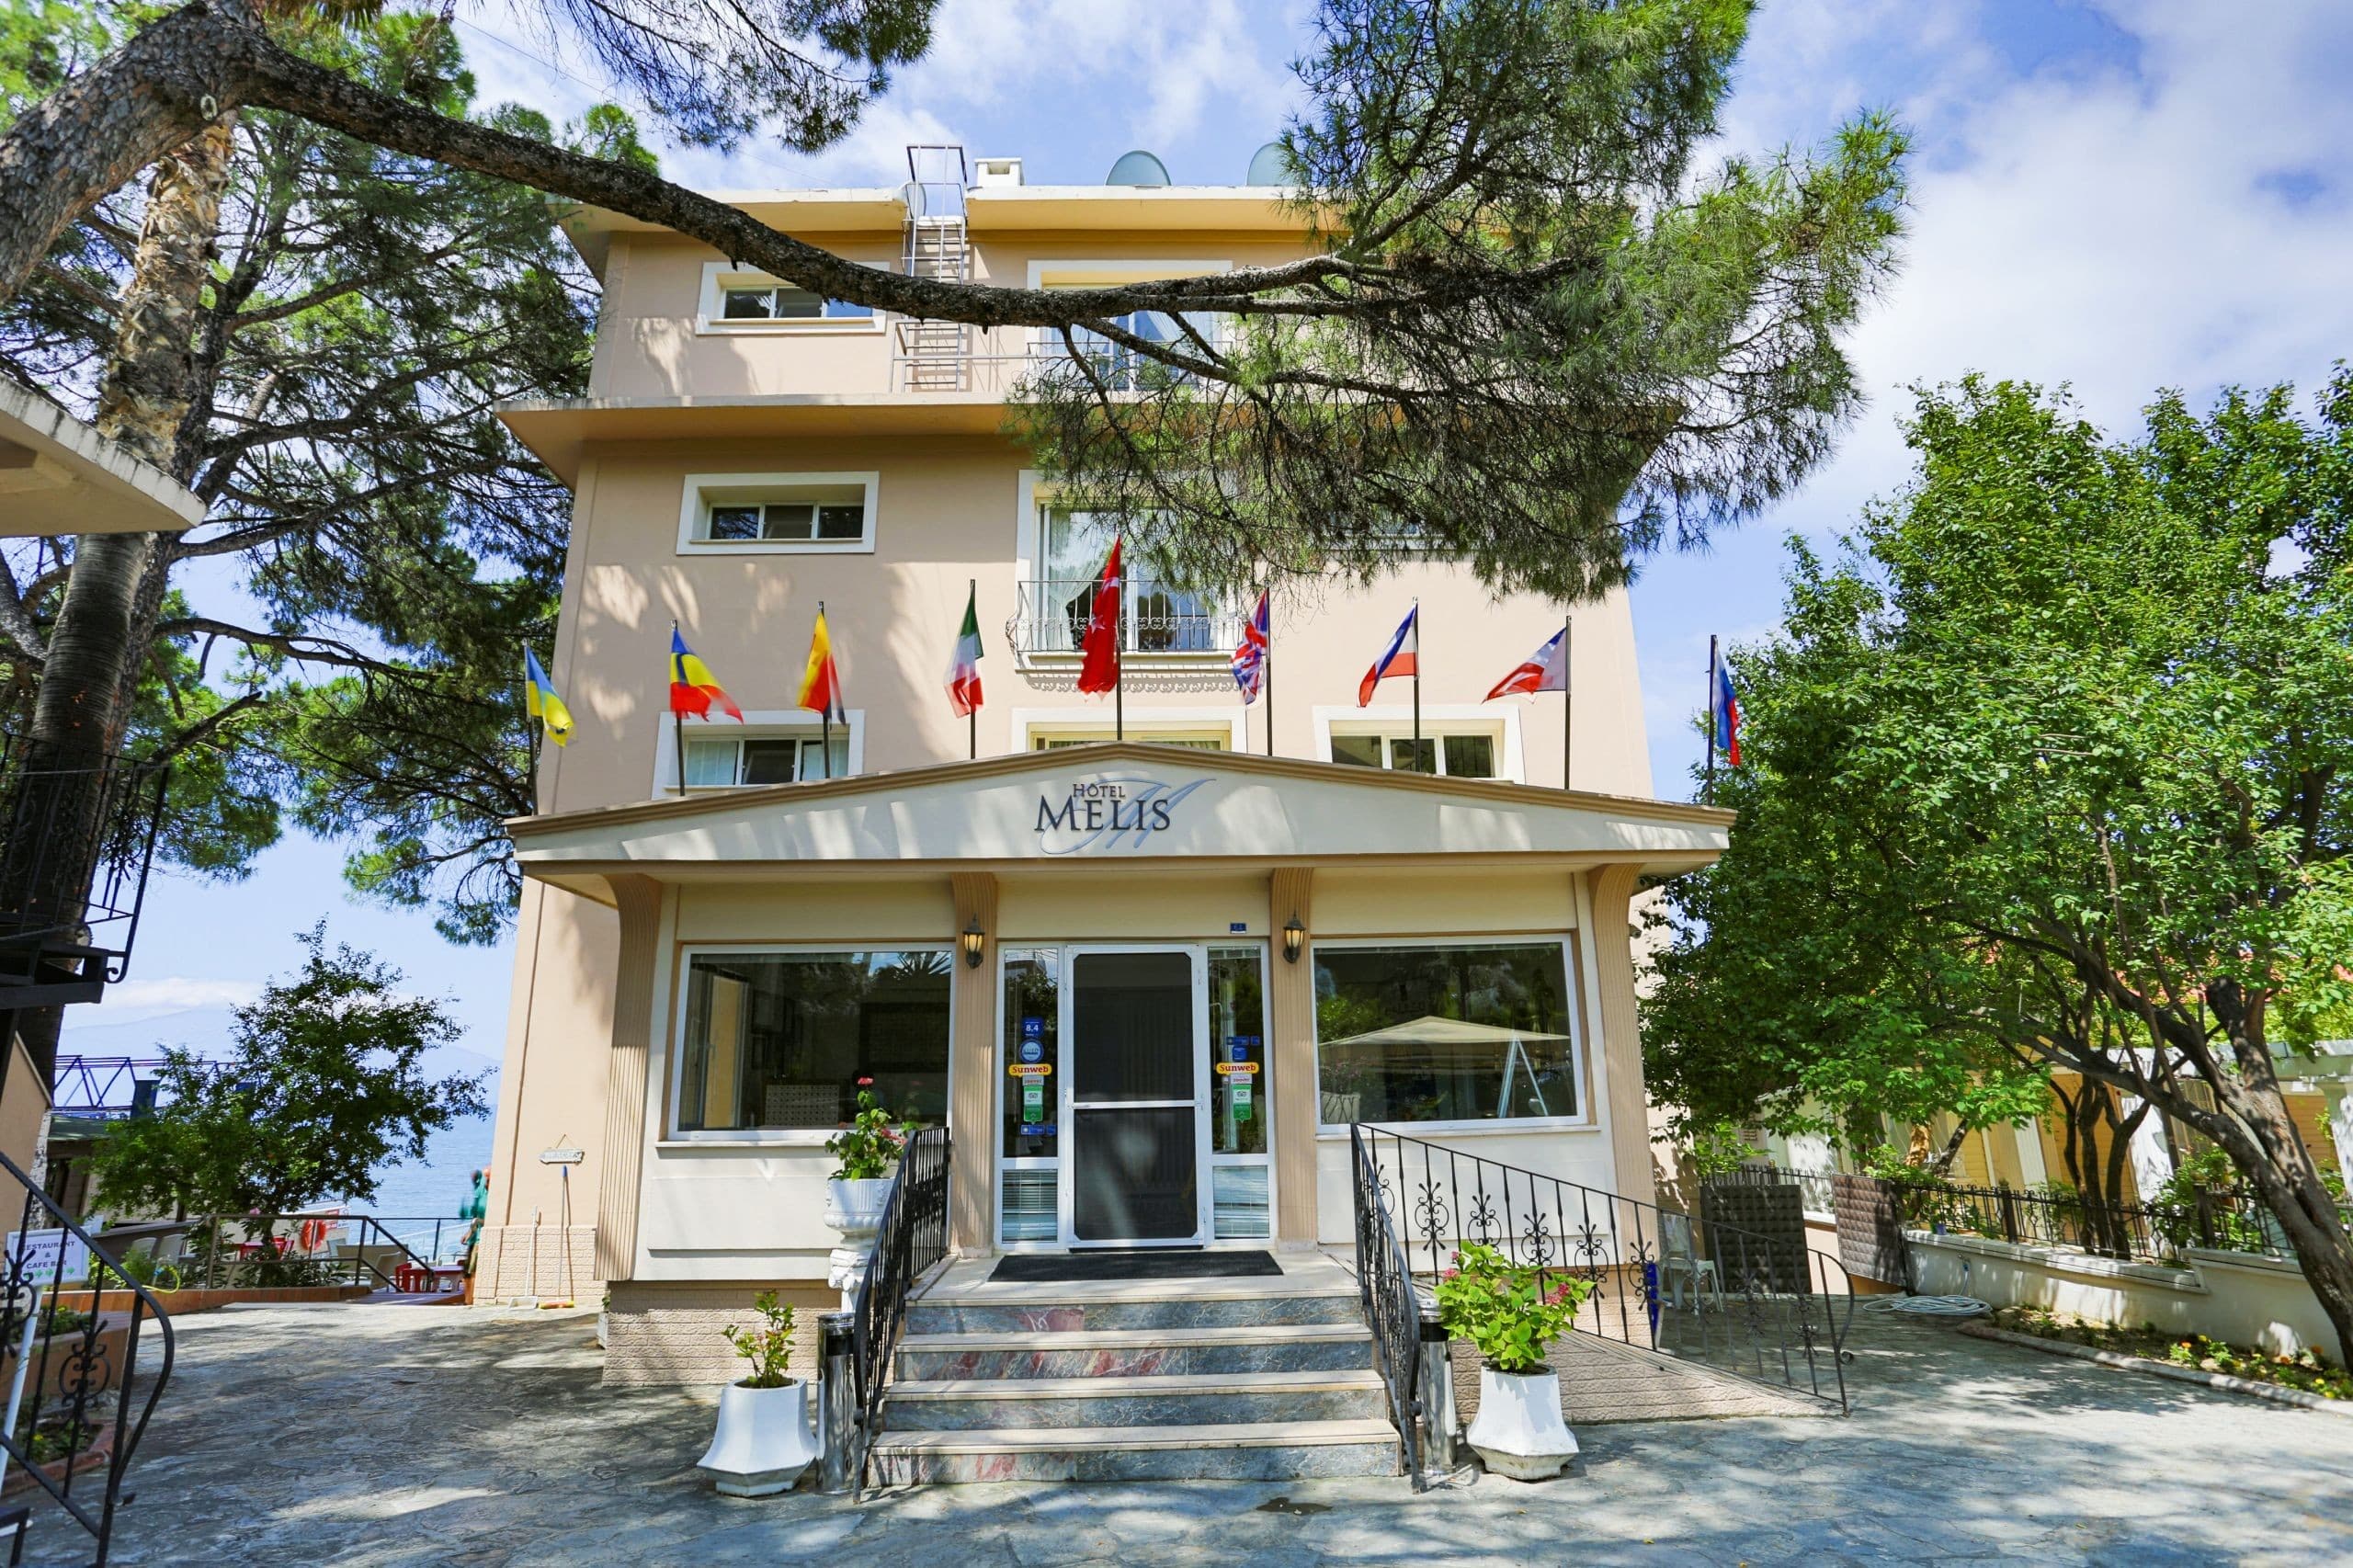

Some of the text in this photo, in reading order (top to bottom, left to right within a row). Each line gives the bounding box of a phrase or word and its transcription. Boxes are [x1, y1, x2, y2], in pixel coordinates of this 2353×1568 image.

[1034, 794, 1171, 832] MELIS
[1012, 1065, 1049, 1074] Sunweb
[1220, 1063, 1256, 1072] Sunweb
[25, 1241, 75, 1251] ESTAURNT
[26, 1261, 48, 1269] CAFE
